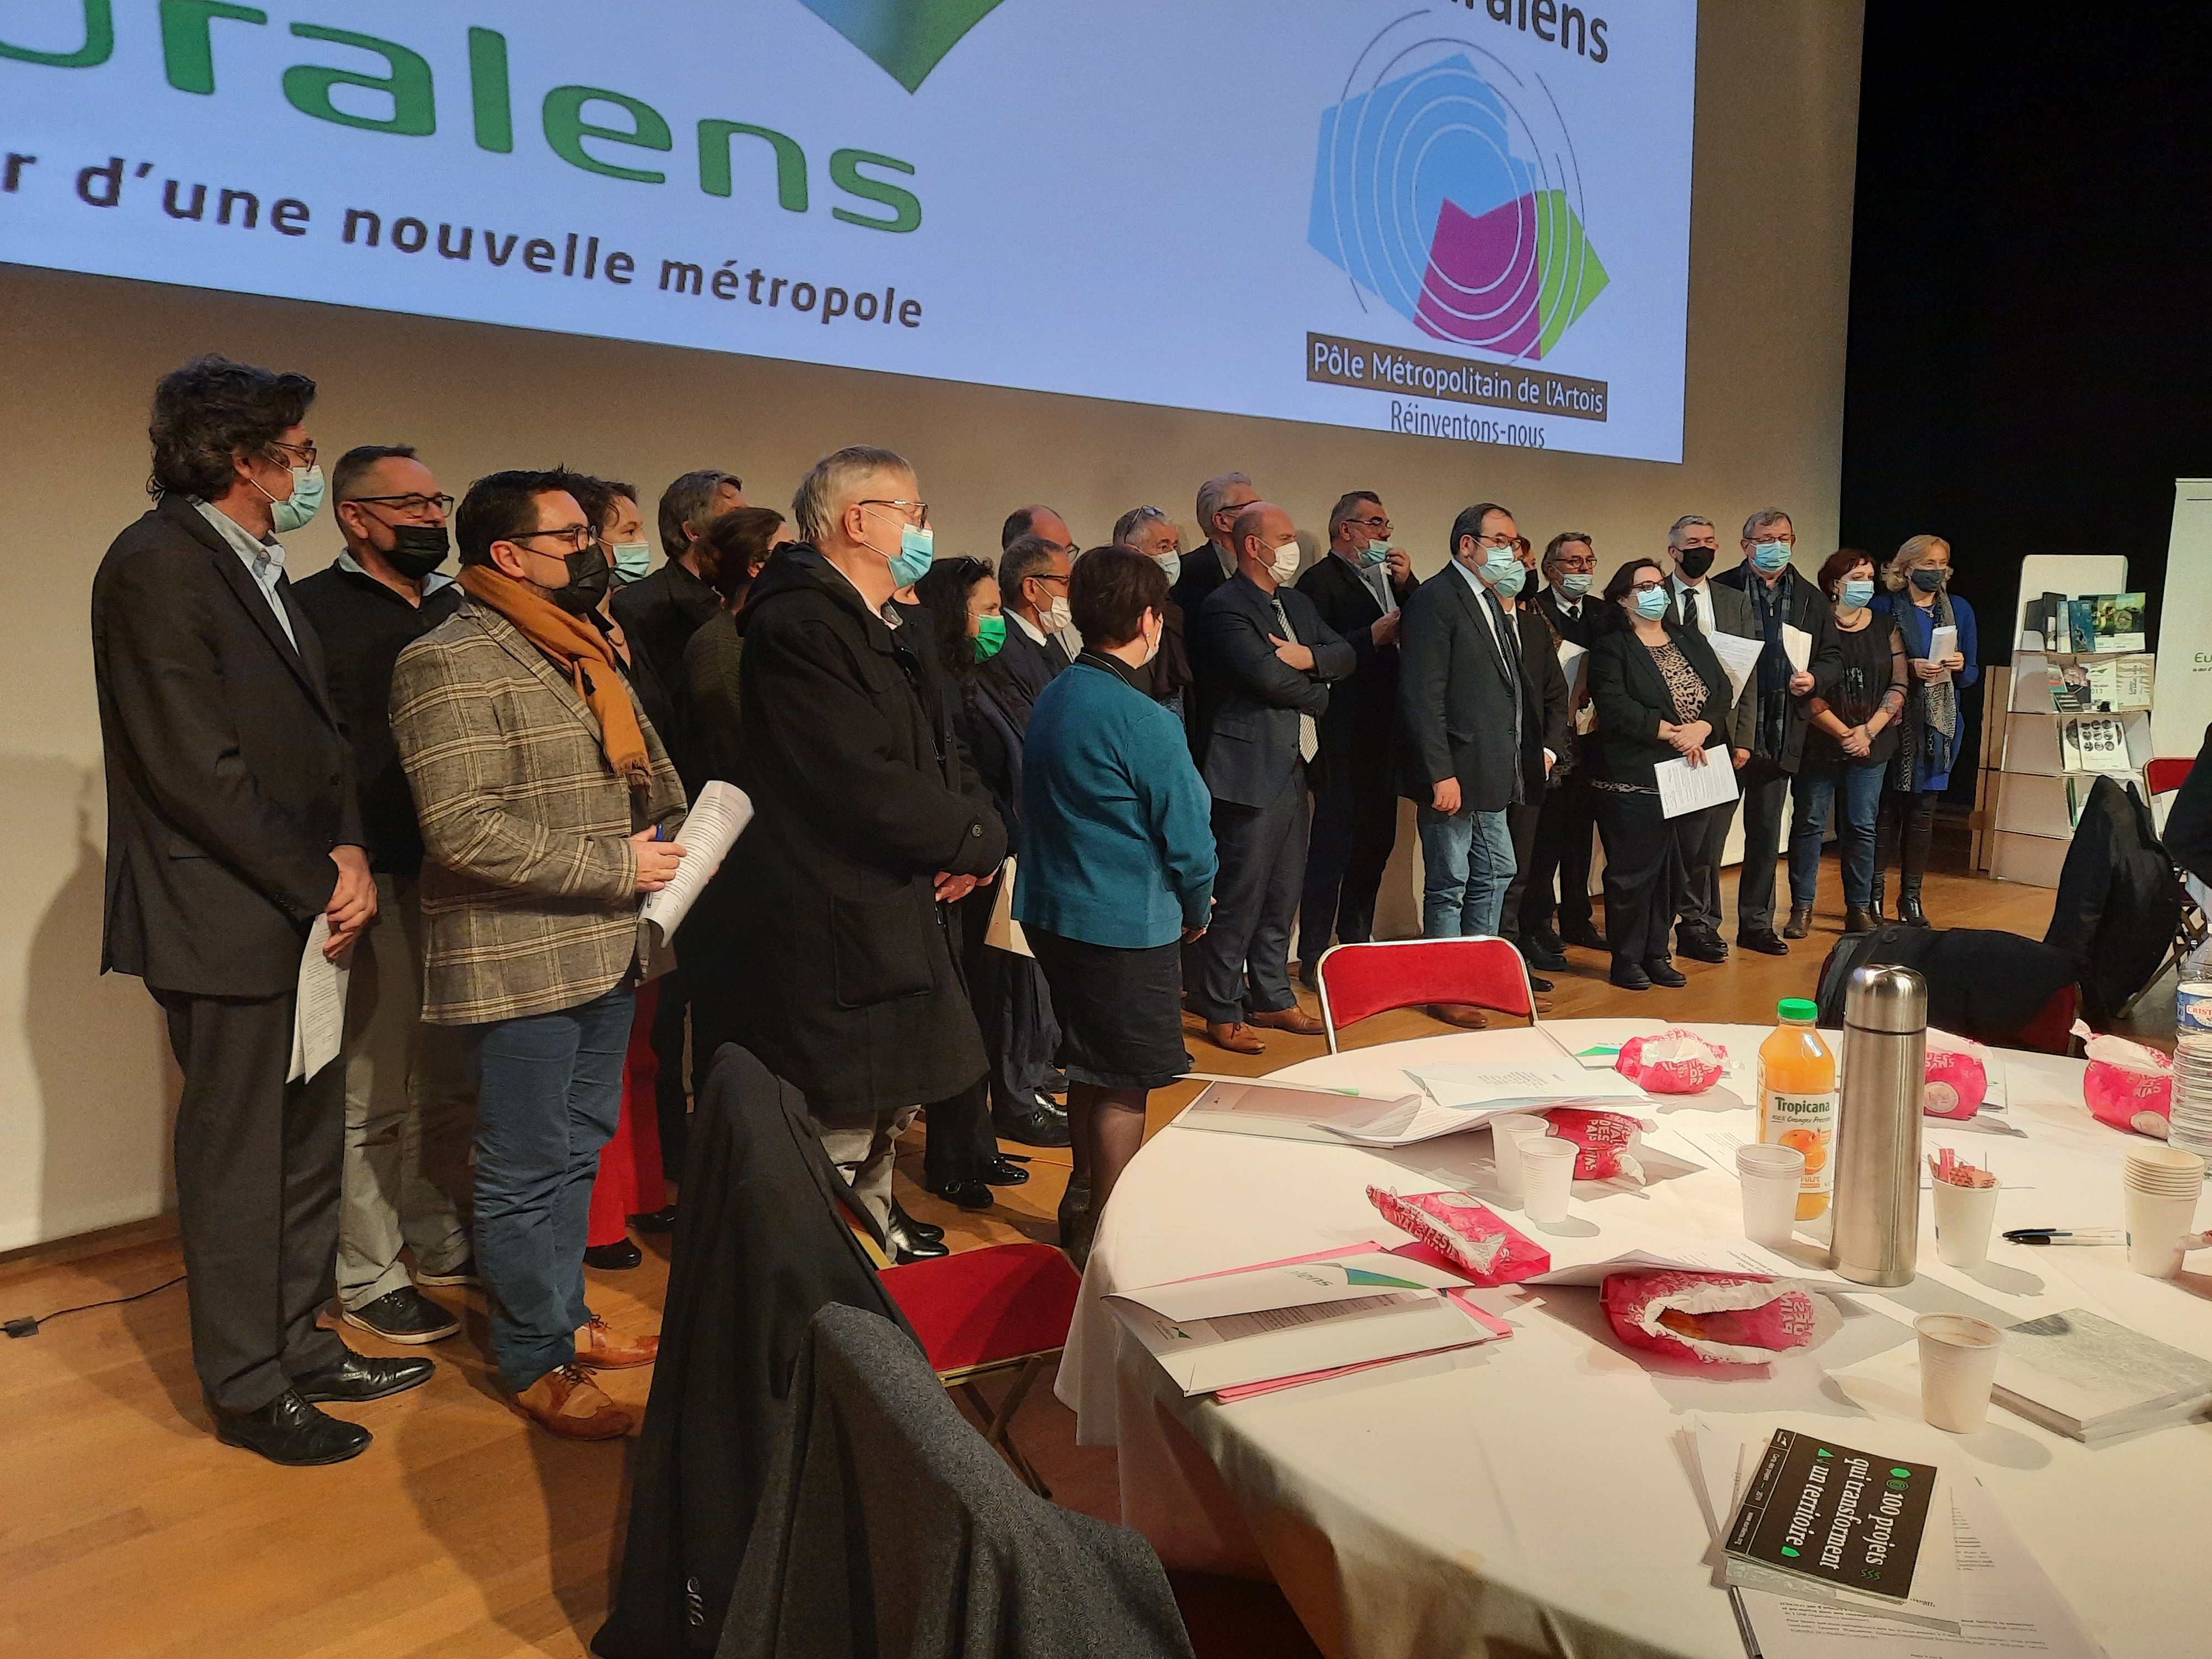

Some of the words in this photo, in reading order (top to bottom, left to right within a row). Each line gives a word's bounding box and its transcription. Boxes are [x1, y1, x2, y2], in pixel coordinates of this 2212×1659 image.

[1451, 0, 1608, 63] alens
[76, 156, 310, 236] d'une
[342, 208, 634, 284] nouvelle
[658, 259, 922, 328] métropole
[1314, 342, 1365, 378] Pôle
[1371, 352, 1512, 398] Métropolitain
[1517, 376, 1540, 404] de
[1546, 380, 1604, 414] l'Artois
[1391, 400, 1545, 448] Réinventons-nous
[1775, 1097, 1830, 1115] Tropicana
[1787, 1116, 1813, 1125] Oranges
[1808, 1465, 1830, 1484] un
[1844, 1458, 1872, 1482] qui
[1785, 1483, 1825, 1546] territoire
[1819, 1480, 1866, 1570] transforment
[1880, 1491, 1904, 1516] 100
[1861, 1513, 1896, 1565] projets
